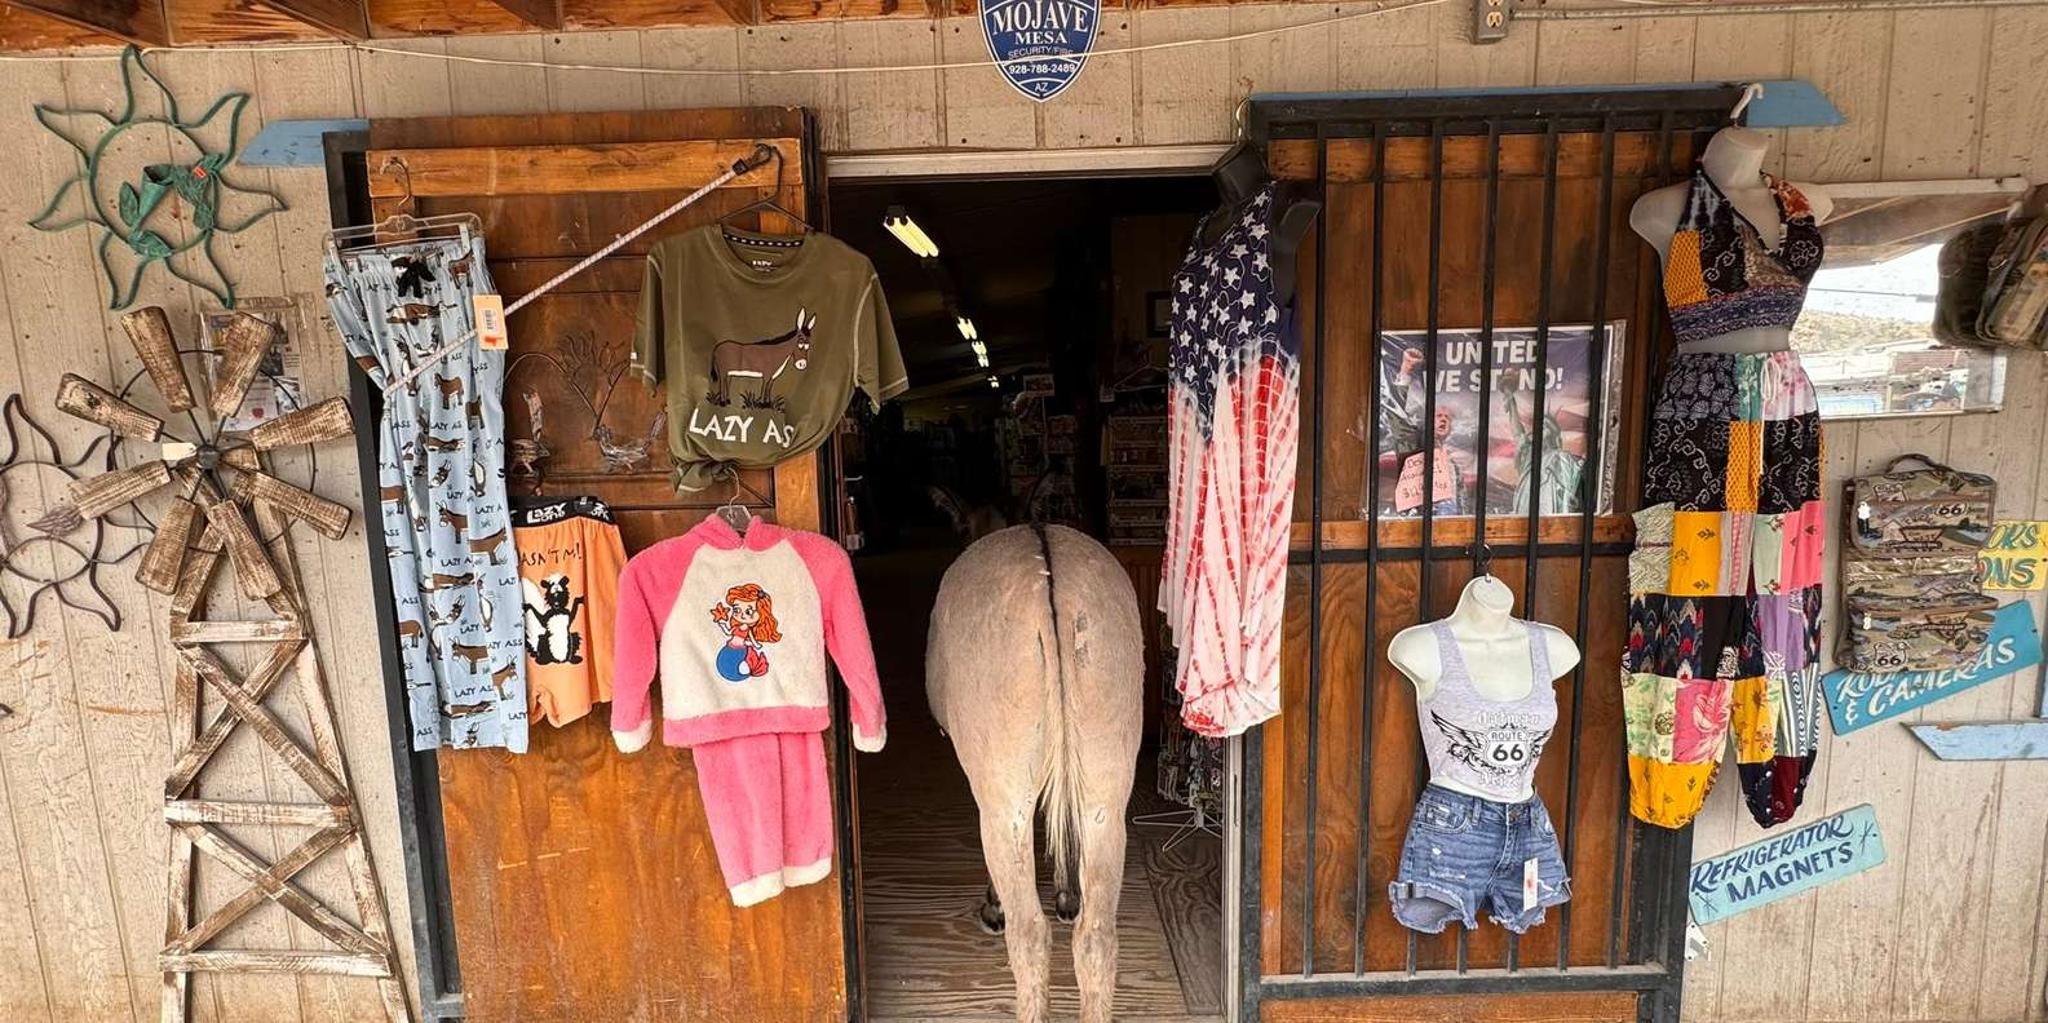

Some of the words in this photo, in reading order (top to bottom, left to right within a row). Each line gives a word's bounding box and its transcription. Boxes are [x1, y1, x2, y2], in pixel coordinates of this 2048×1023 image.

[993, 1, 1088, 35] MOJAVE
[1015, 31, 1067, 45] MESA
[1034, 83, 1048, 92] AZ
[1446, 340, 1540, 365] UNTED
[1469, 367, 1563, 392] STND!
[689, 408, 753, 443] LAZY
[1938, 504, 1962, 515] 66
[505, 639, 523, 647] ASS
[1877, 655, 1901, 665] 66
[454, 688, 476, 698] LAZY
[416, 728, 433, 736] ASS
[1491, 731, 1523, 740] ROUTE
[1492, 743, 1524, 762] 66
[1690, 815, 1854, 893] REFRIGERATOR
[1727, 841, 1853, 903] MAGNETS
